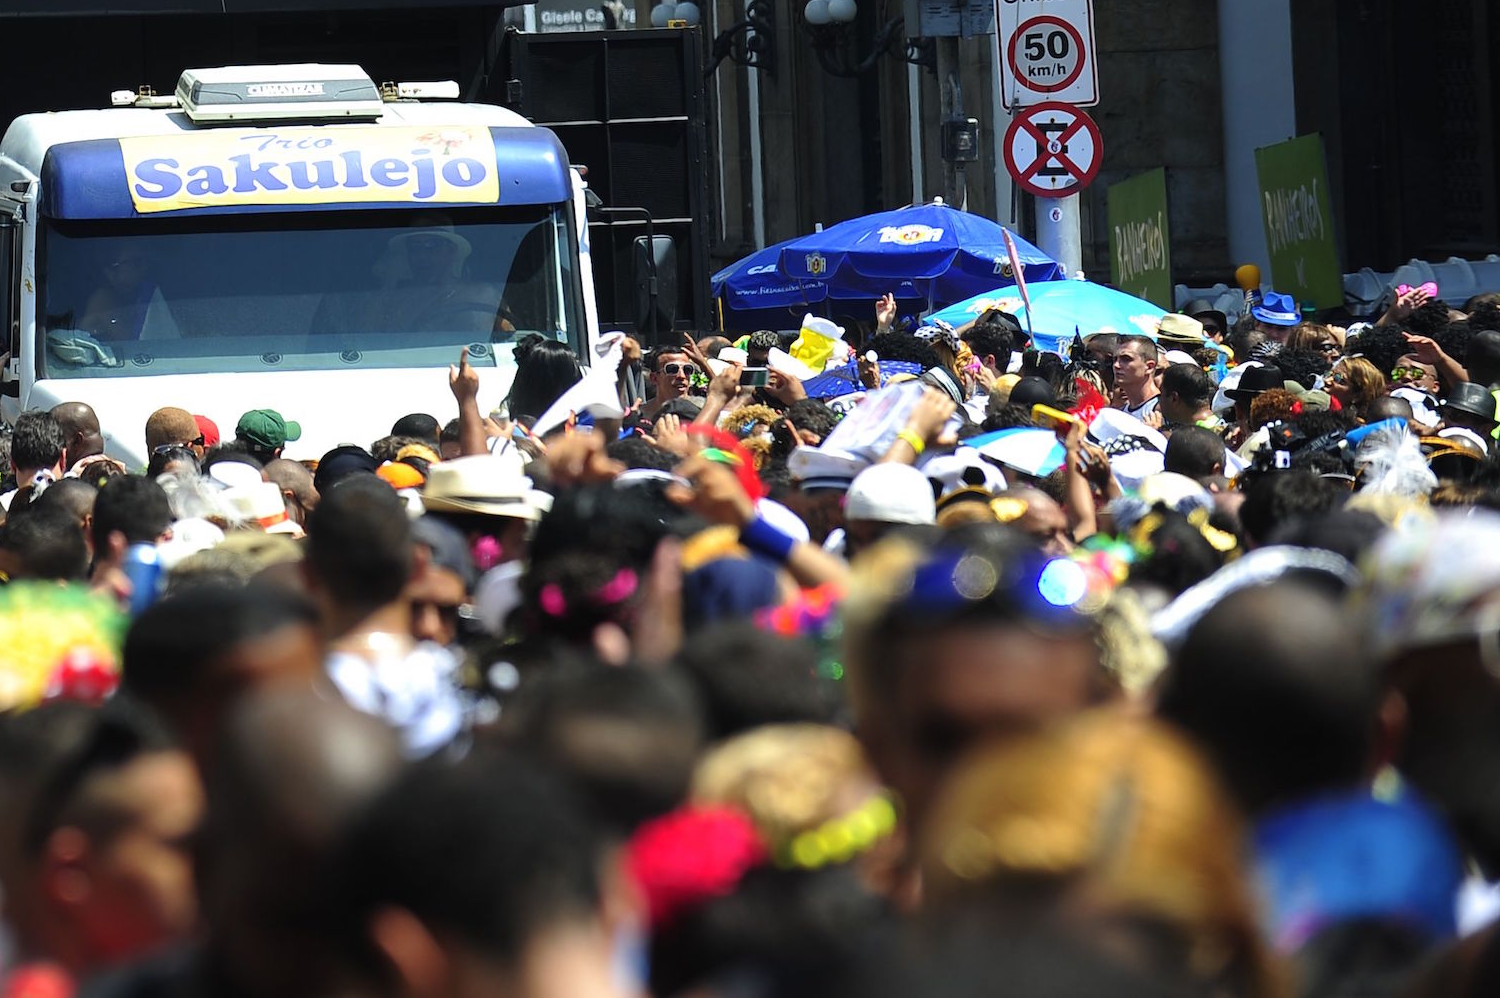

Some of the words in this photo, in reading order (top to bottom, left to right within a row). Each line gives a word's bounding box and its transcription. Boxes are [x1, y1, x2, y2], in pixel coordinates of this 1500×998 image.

[1024, 31, 1069, 61] 50
[1028, 63, 1066, 77] km/h
[240, 134, 333, 151] Trio
[135, 149, 486, 199] Sakulejo
